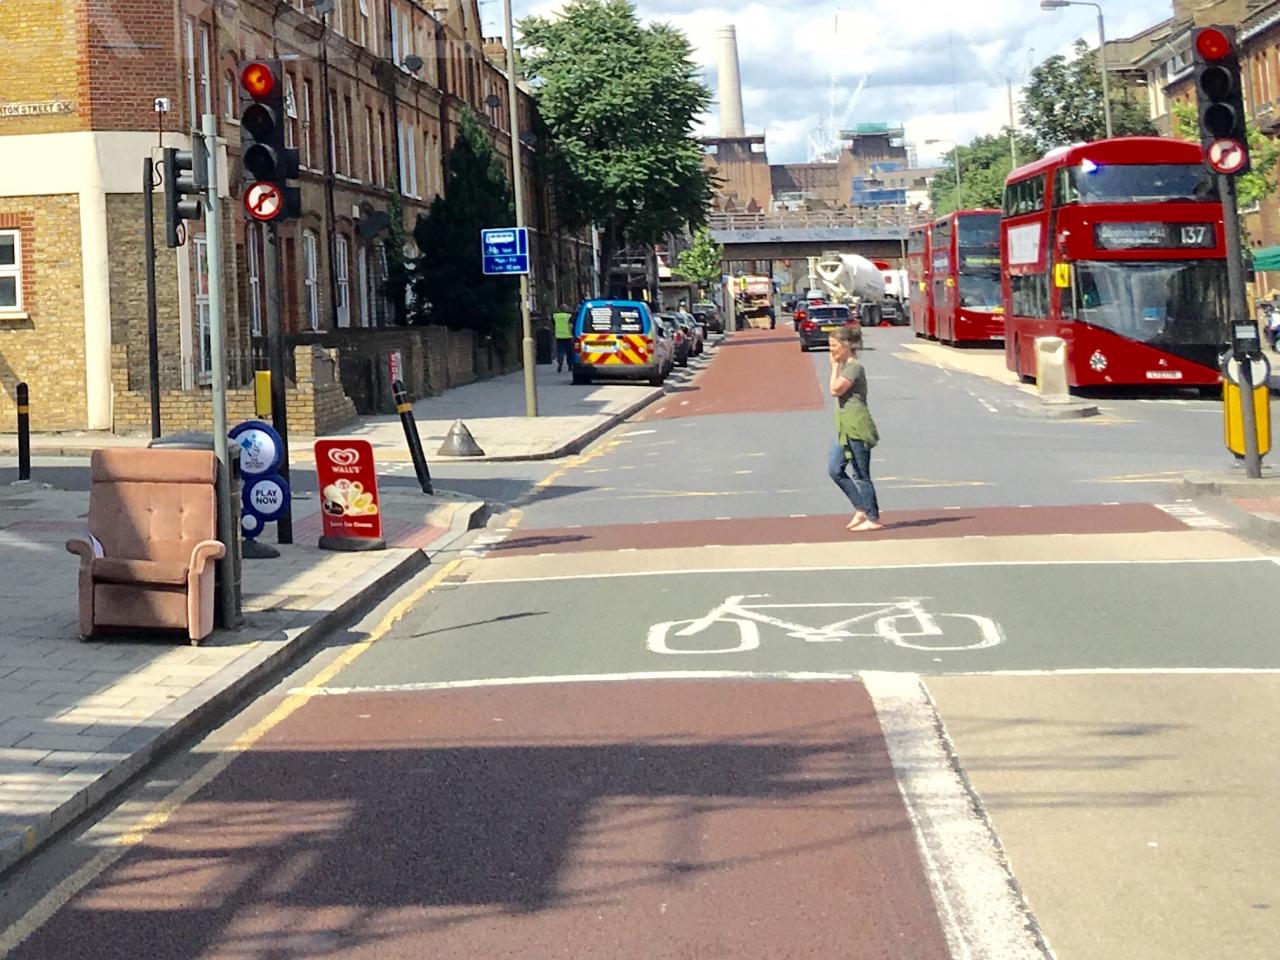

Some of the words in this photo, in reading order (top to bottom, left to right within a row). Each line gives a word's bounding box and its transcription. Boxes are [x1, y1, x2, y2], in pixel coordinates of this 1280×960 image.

[21, 103, 53, 113] STREET
[1181, 226, 1206, 244] 137
[331, 466, 360, 474] WALL'S
[255, 489, 277, 497] PLAY
[255, 496, 278, 505] NOW
